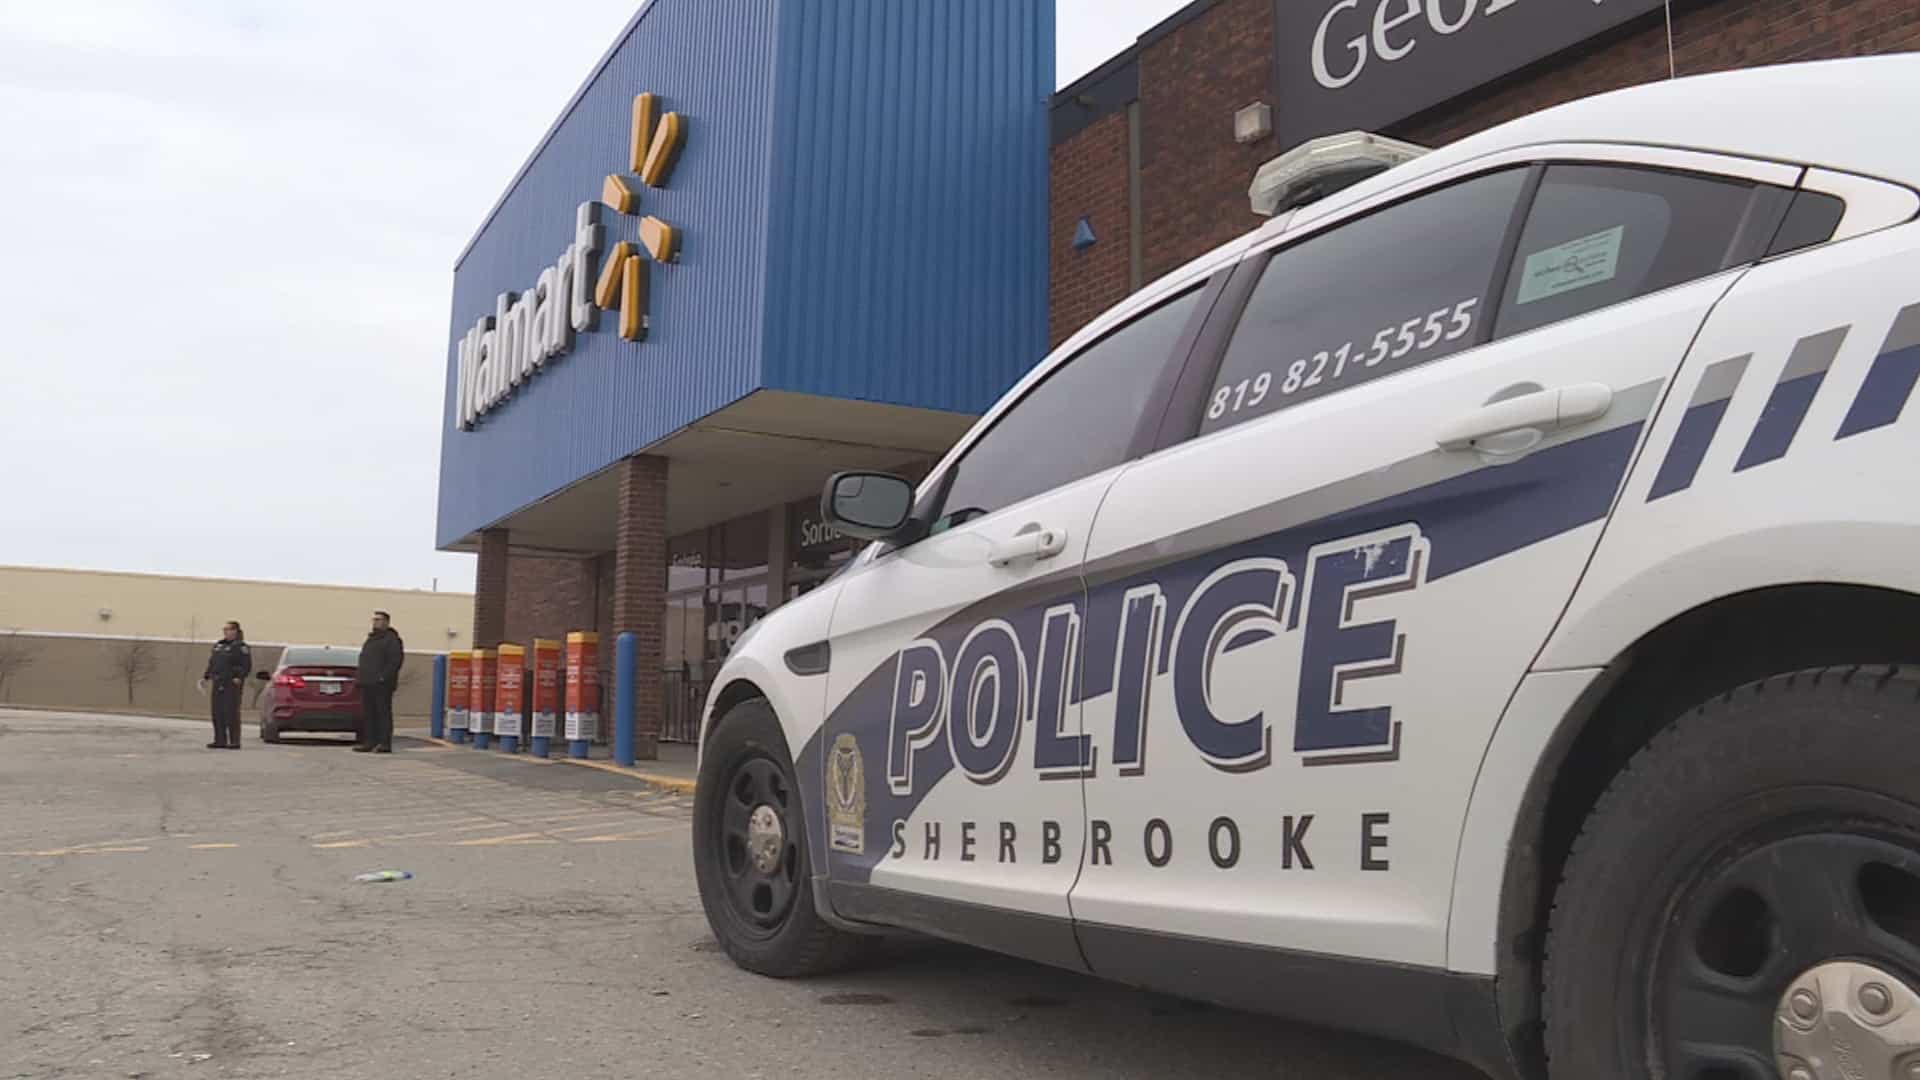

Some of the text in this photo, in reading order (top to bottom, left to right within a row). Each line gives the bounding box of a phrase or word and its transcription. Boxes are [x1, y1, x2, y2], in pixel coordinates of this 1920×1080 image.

[456, 200, 606, 431] Walmart
[1208, 297, 1478, 420] 819 821-5555
[887, 522, 1432, 796] POLICE
[892, 812, 1391, 872] SHERBROOKE
